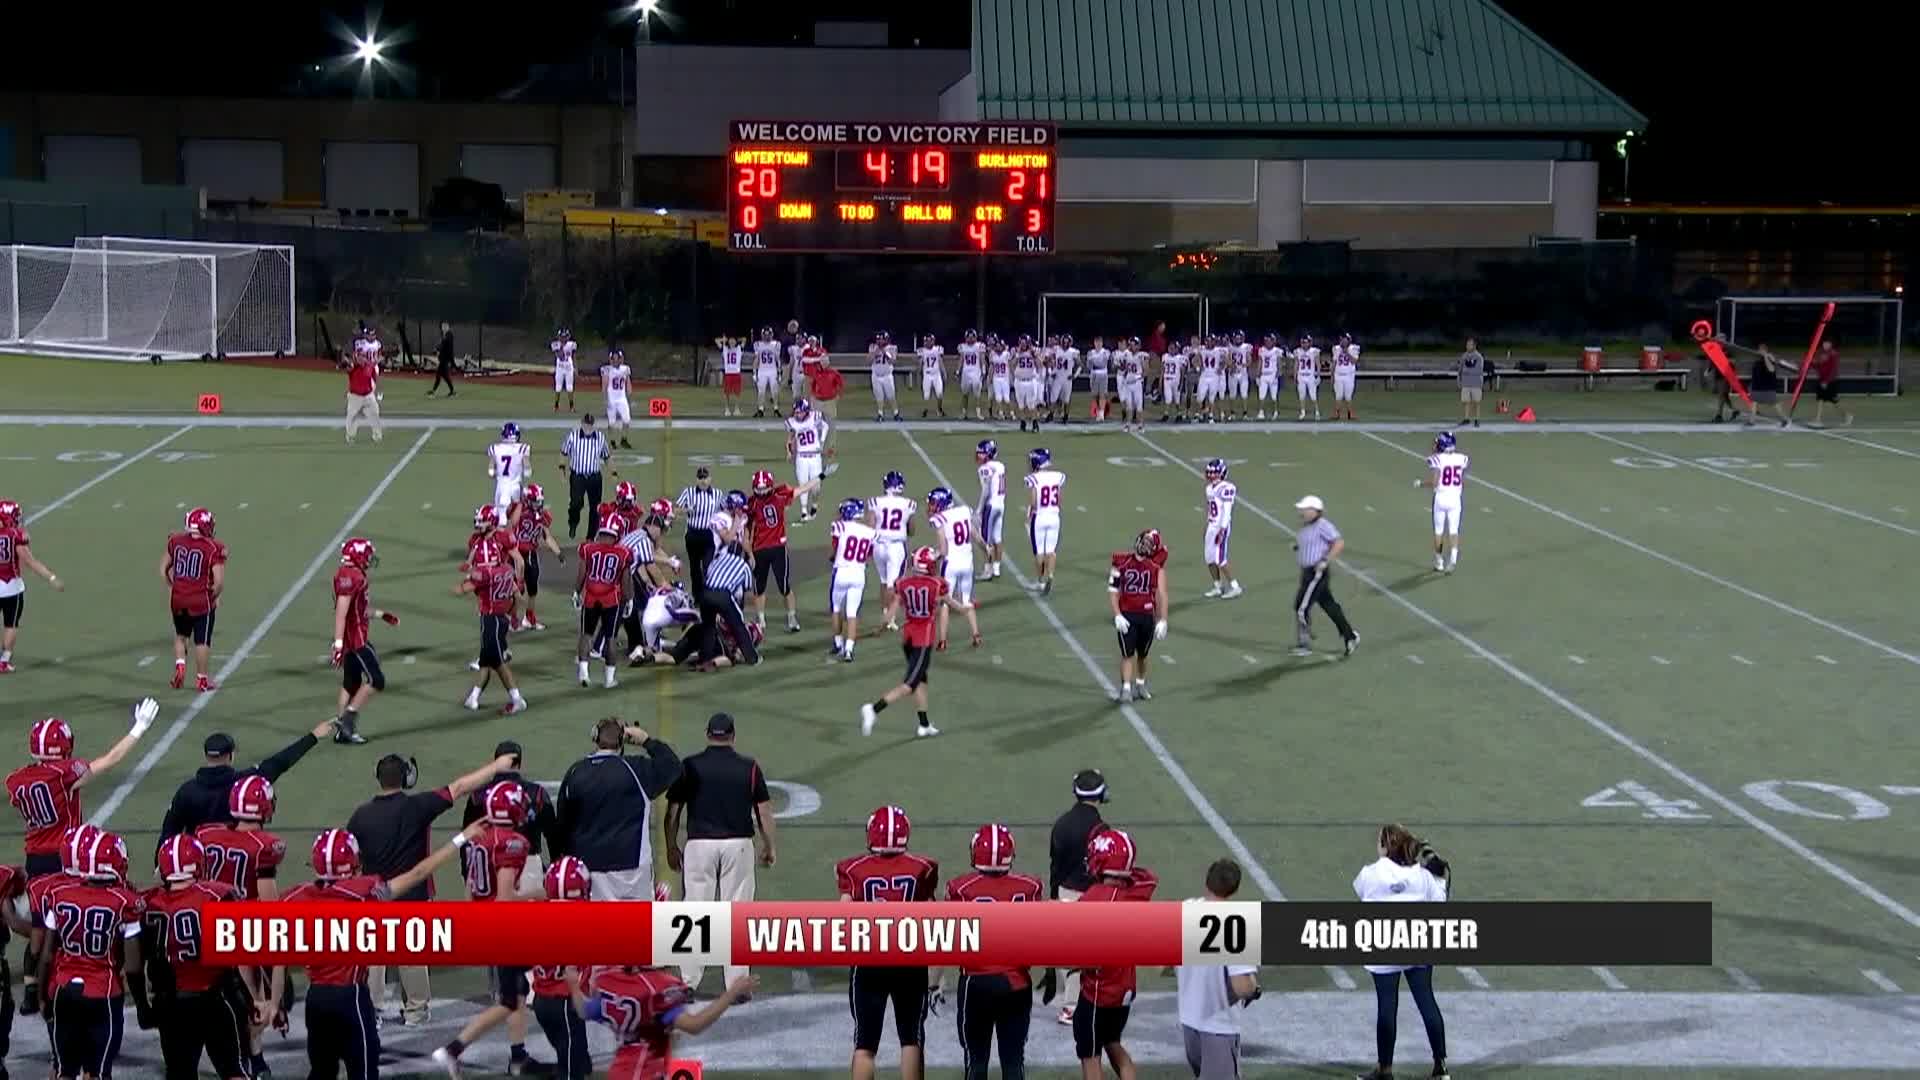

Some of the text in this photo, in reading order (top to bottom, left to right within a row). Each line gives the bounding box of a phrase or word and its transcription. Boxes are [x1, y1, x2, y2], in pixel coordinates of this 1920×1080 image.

[738, 124, 1047, 144] WELCOME TO VICTORY FIELD
[734, 151, 808, 165] WATERTOWN
[866, 151, 945, 184] 4:19
[738, 169, 777, 197] 20
[1008, 171, 1045, 200] 21
[743, 206, 756, 228] 0
[779, 204, 812, 219] DOWN
[839, 205, 874, 219] TO GO
[904, 206, 952, 220] BALL ON
[975, 206, 1002, 221] QTR
[1028, 209, 1041, 231] 3
[734, 233, 767, 249] T.O.L.
[969, 223, 987, 249] 4
[1016, 236, 1049, 251] T.O.L.
[200, 397, 217, 411] 40
[652, 401, 667, 413] 50
[799, 431, 815, 445] 20
[501, 456, 512, 476] 7
[1441, 466, 1462, 487] 85
[1040, 485, 1059, 506] 83
[762, 503, 778, 528] 9
[880, 508, 903, 530] 12
[953, 519, 970, 546] 81
[843, 535, 870, 563] 88
[173, 545, 204, 579] 60
[590, 551, 620, 583] 18
[1123, 568, 1151, 594] 21
[903, 585, 930, 618] 11
[15, 780, 60, 830] 10
[1580, 779, 1892, 821] 40
[56, 903, 116, 959] 28
[146, 910, 201, 962] 79
[602, 990, 641, 1044] 52
